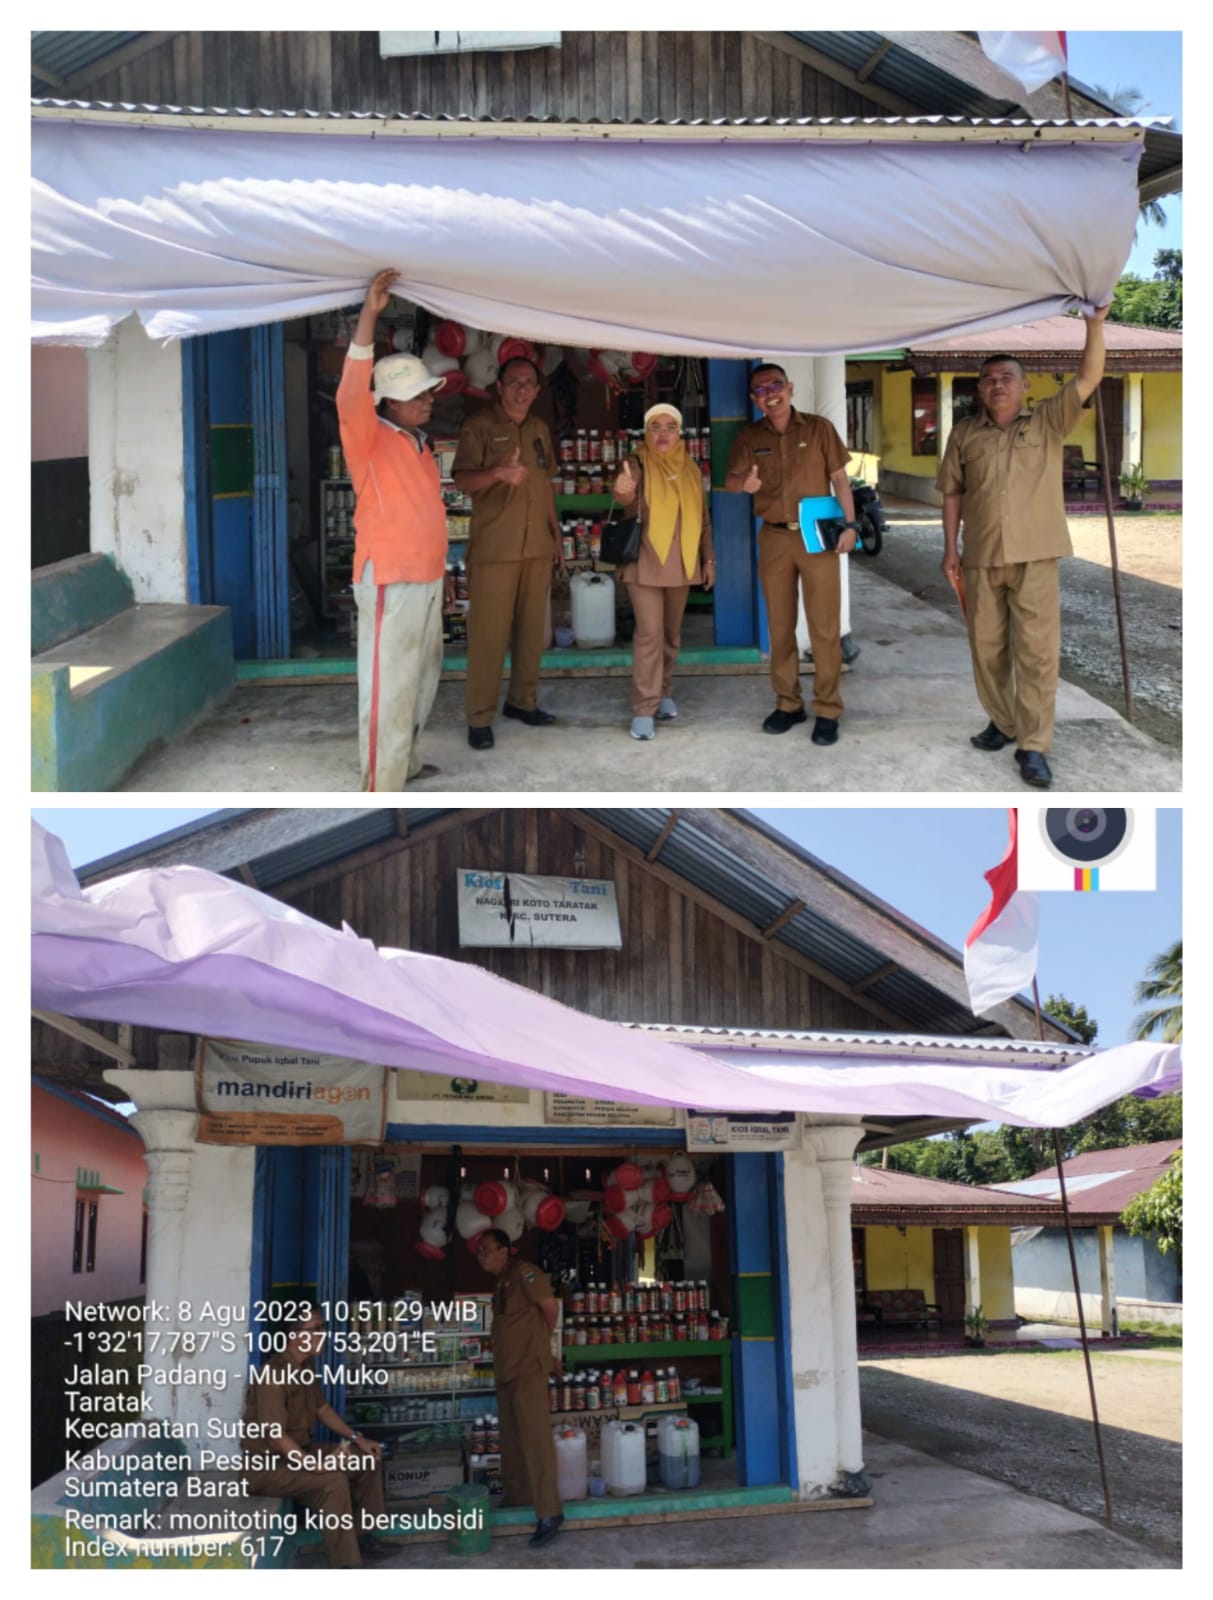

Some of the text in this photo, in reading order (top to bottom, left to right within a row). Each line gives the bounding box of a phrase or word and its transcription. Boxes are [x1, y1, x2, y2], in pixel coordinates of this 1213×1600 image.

[464, 873, 608, 896] Kios Tani
[523, 899, 550, 910] KOTO
[554, 901, 598, 911] TARATAK
[534, 913, 577, 922] SUTERA
[242, 1055, 272, 1064] Pupuk
[301, 1057, 320, 1065] Tani
